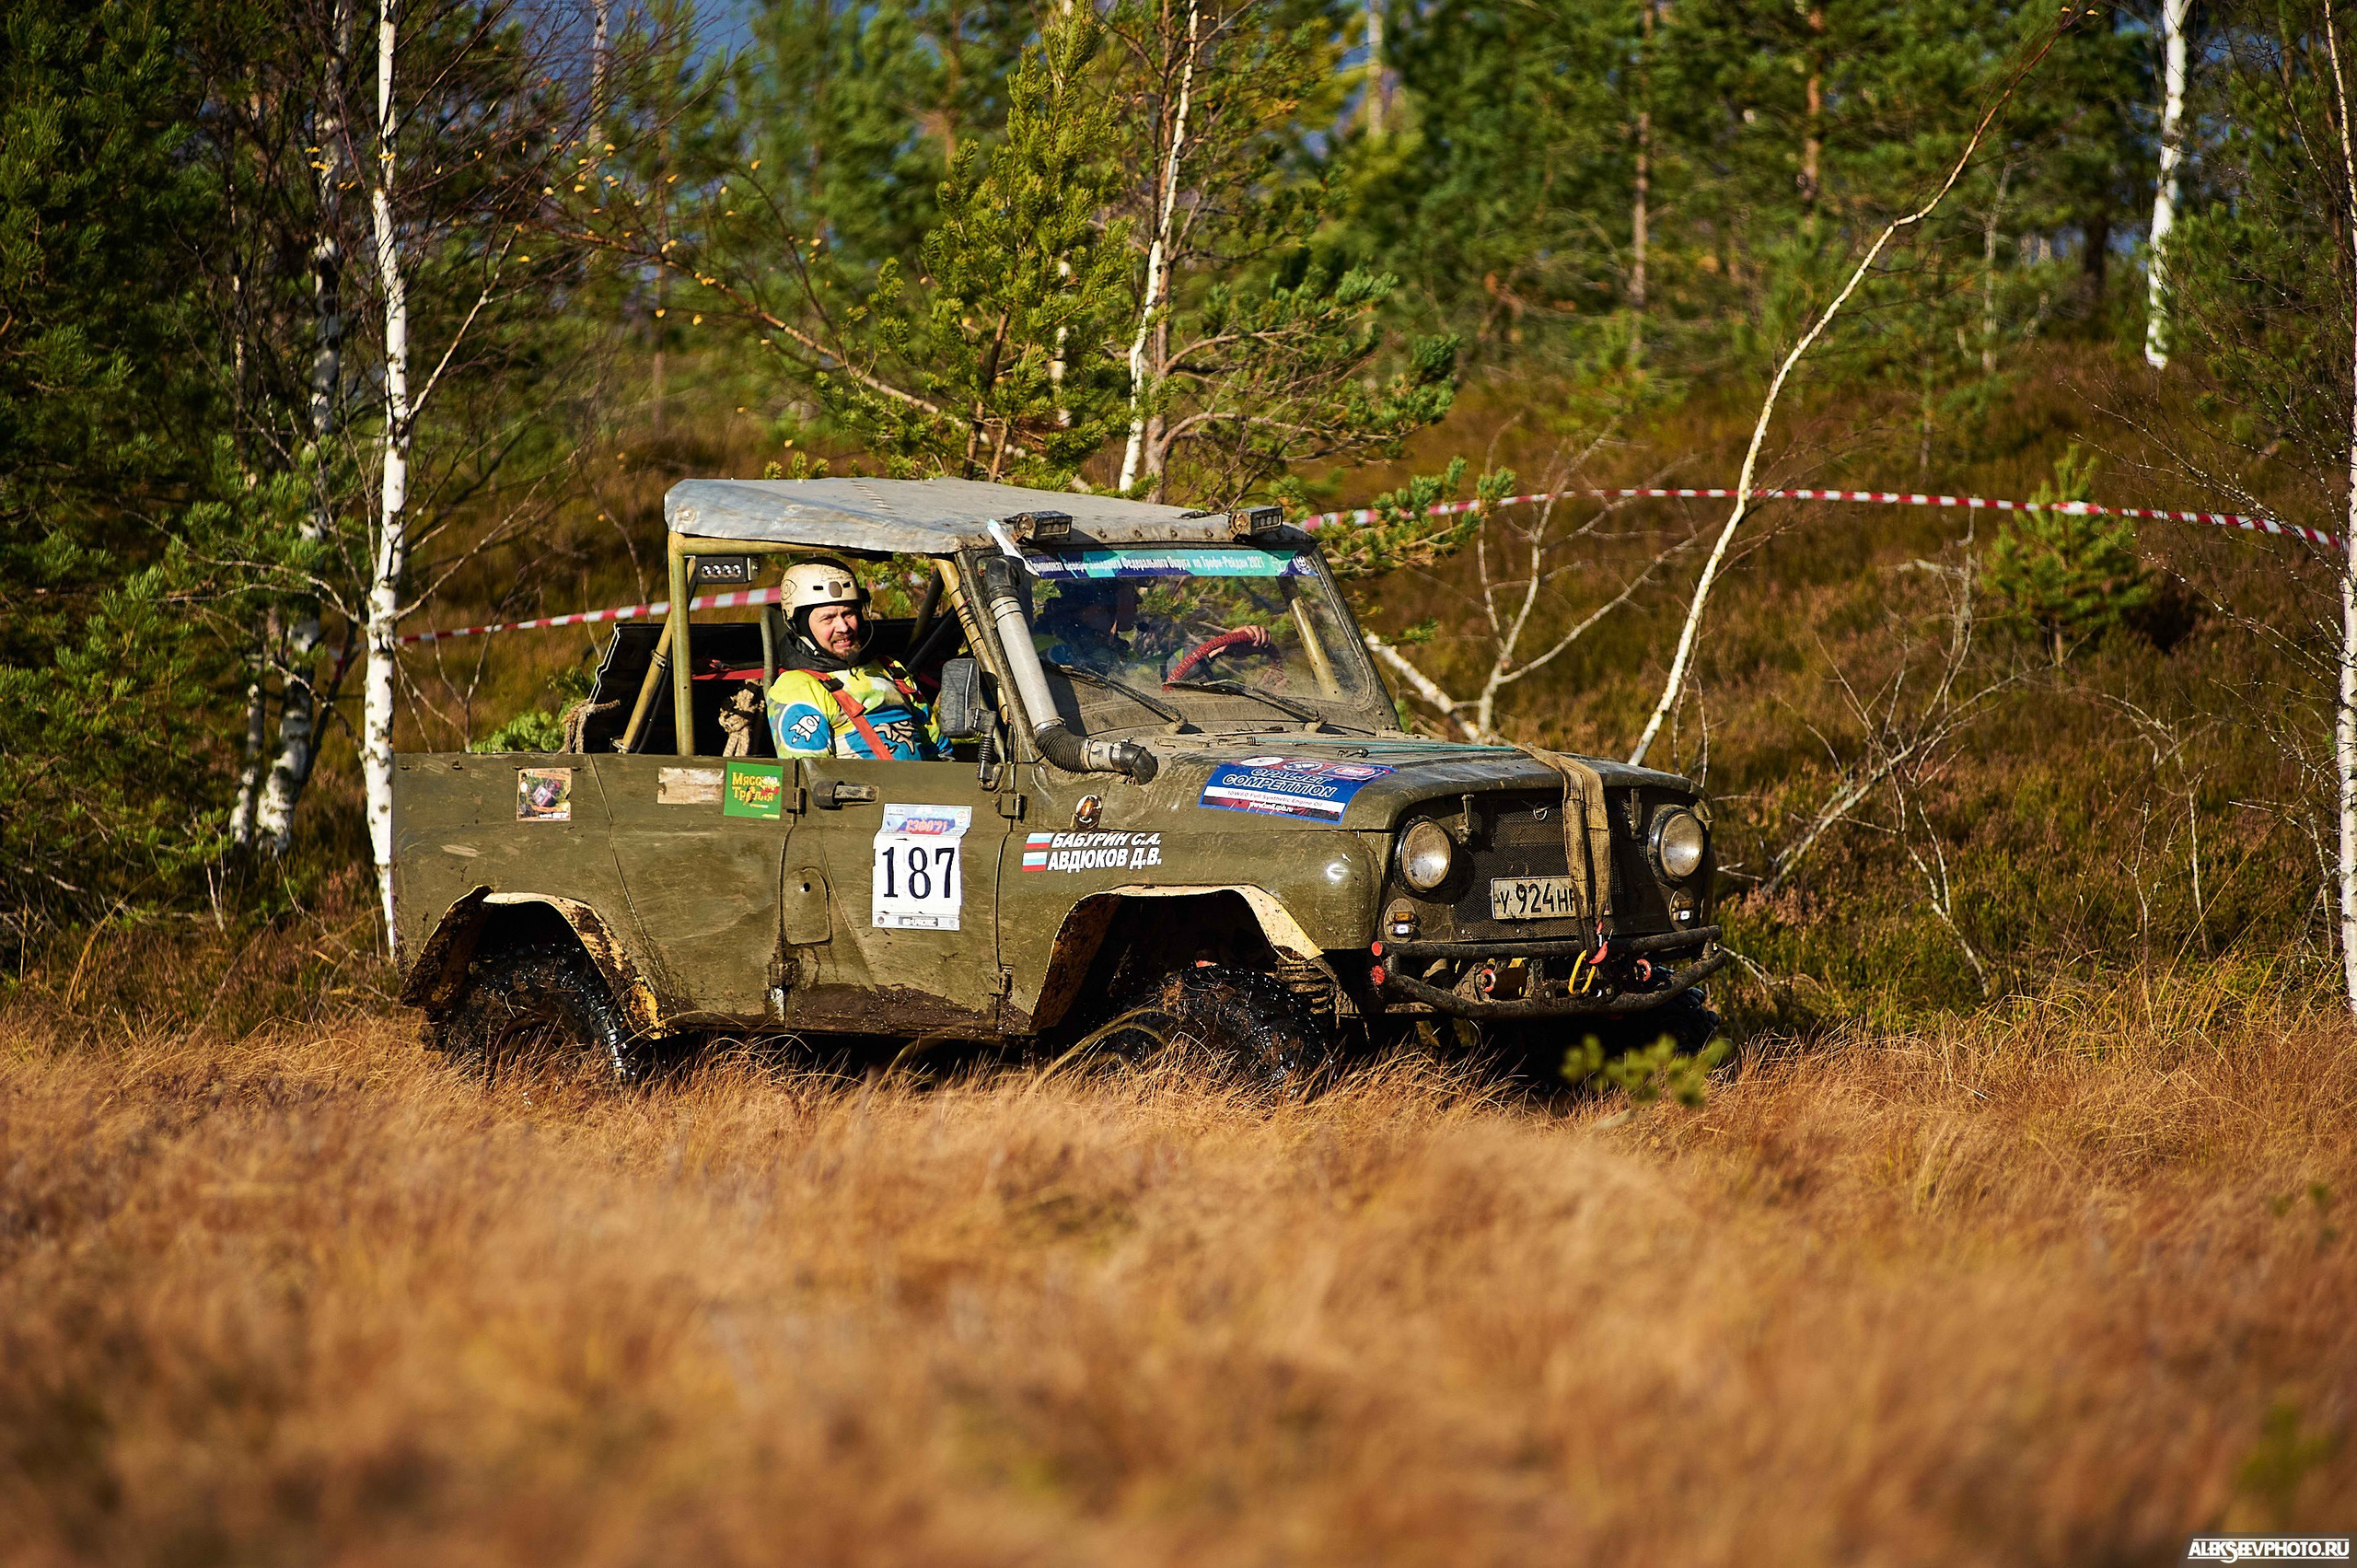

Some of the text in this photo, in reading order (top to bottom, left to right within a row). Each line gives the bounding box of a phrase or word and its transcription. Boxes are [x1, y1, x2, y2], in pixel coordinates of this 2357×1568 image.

[1120, 555, 1169, 571] Федерального
[1167, 555, 1191, 571] Округа
[1192, 558, 1202, 569] по
[1247, 555, 1265, 569] 2021
[1250, 768, 1335, 784] OPALJET
[1222, 774, 1338, 798] COMPETITION
[1262, 794, 1291, 805] Synthetic
[1292, 796, 1312, 807] Engine
[1051, 832, 1162, 848] БАБУРИН С.А.
[1047, 847, 1163, 873] АВДЮКОВ Д.В.
[882, 846, 955, 900] 187
